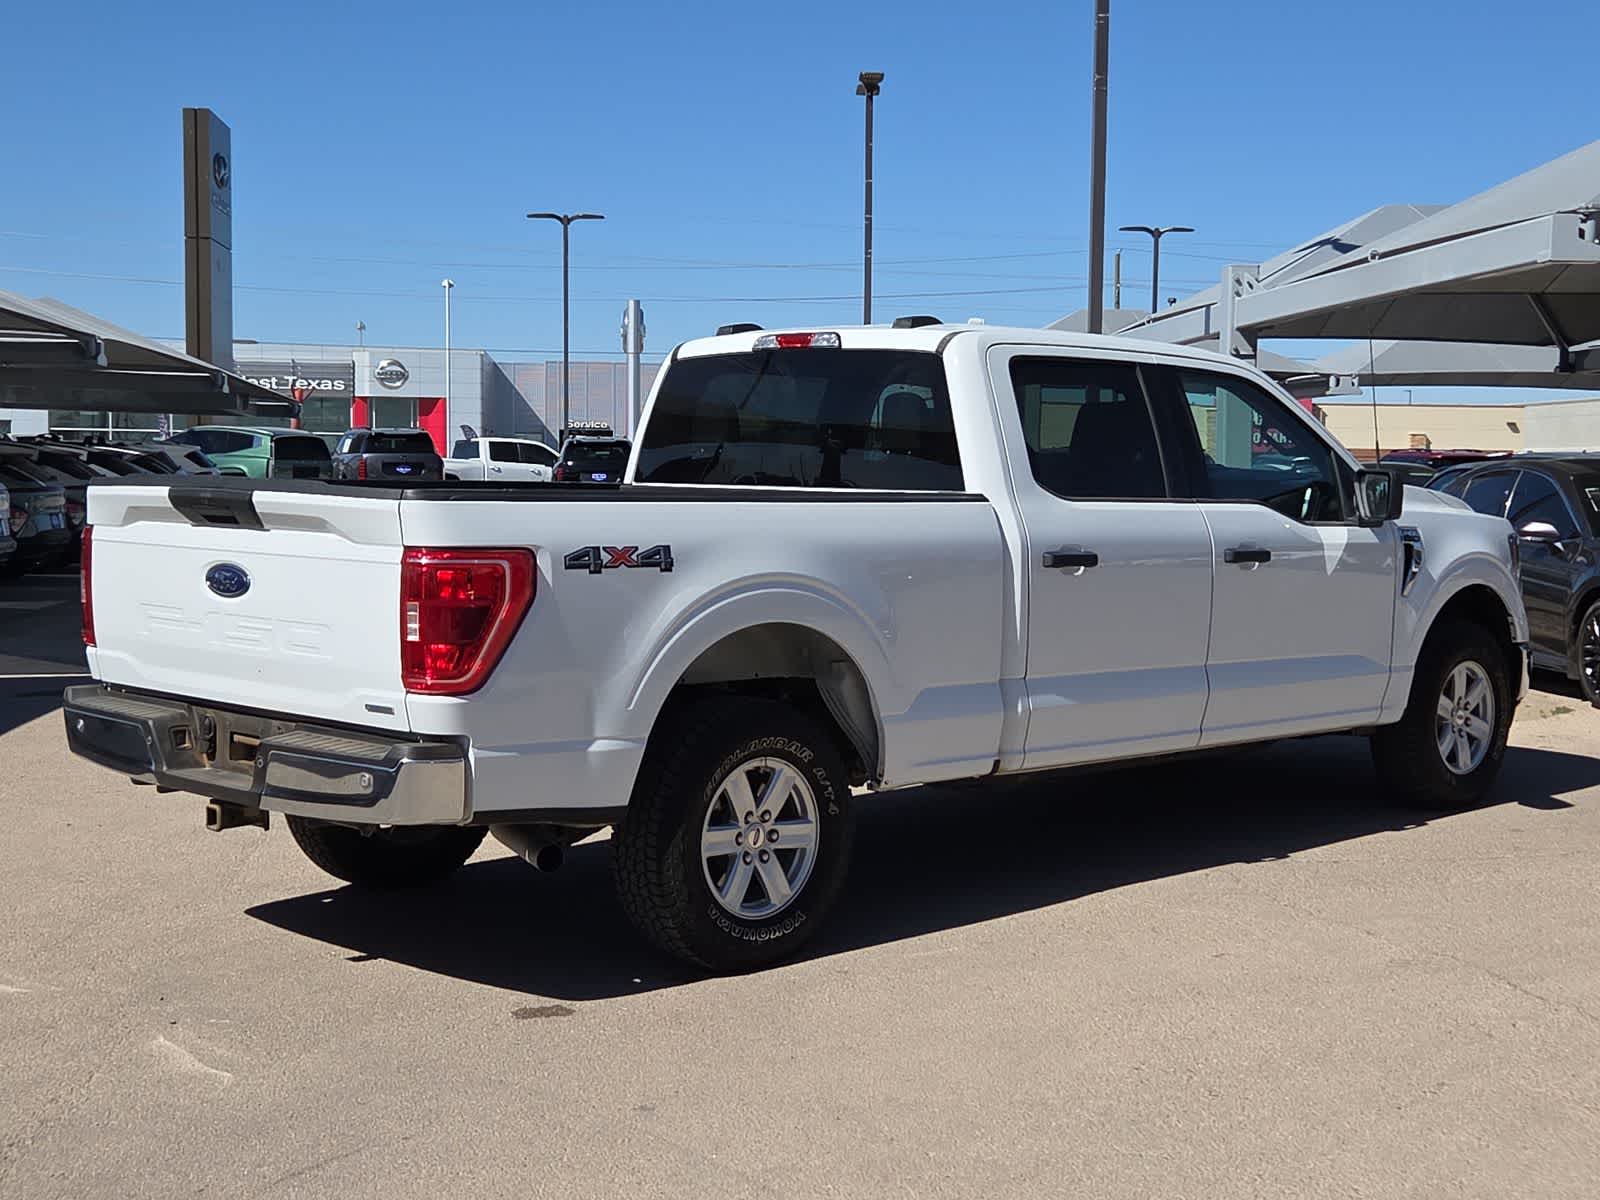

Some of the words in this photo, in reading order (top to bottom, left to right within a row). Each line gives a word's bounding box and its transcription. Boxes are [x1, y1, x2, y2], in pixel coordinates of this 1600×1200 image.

[241, 375, 279, 390] est
[283, 375, 345, 390] Texas
[707, 904, 807, 941] YOKOHAMA
